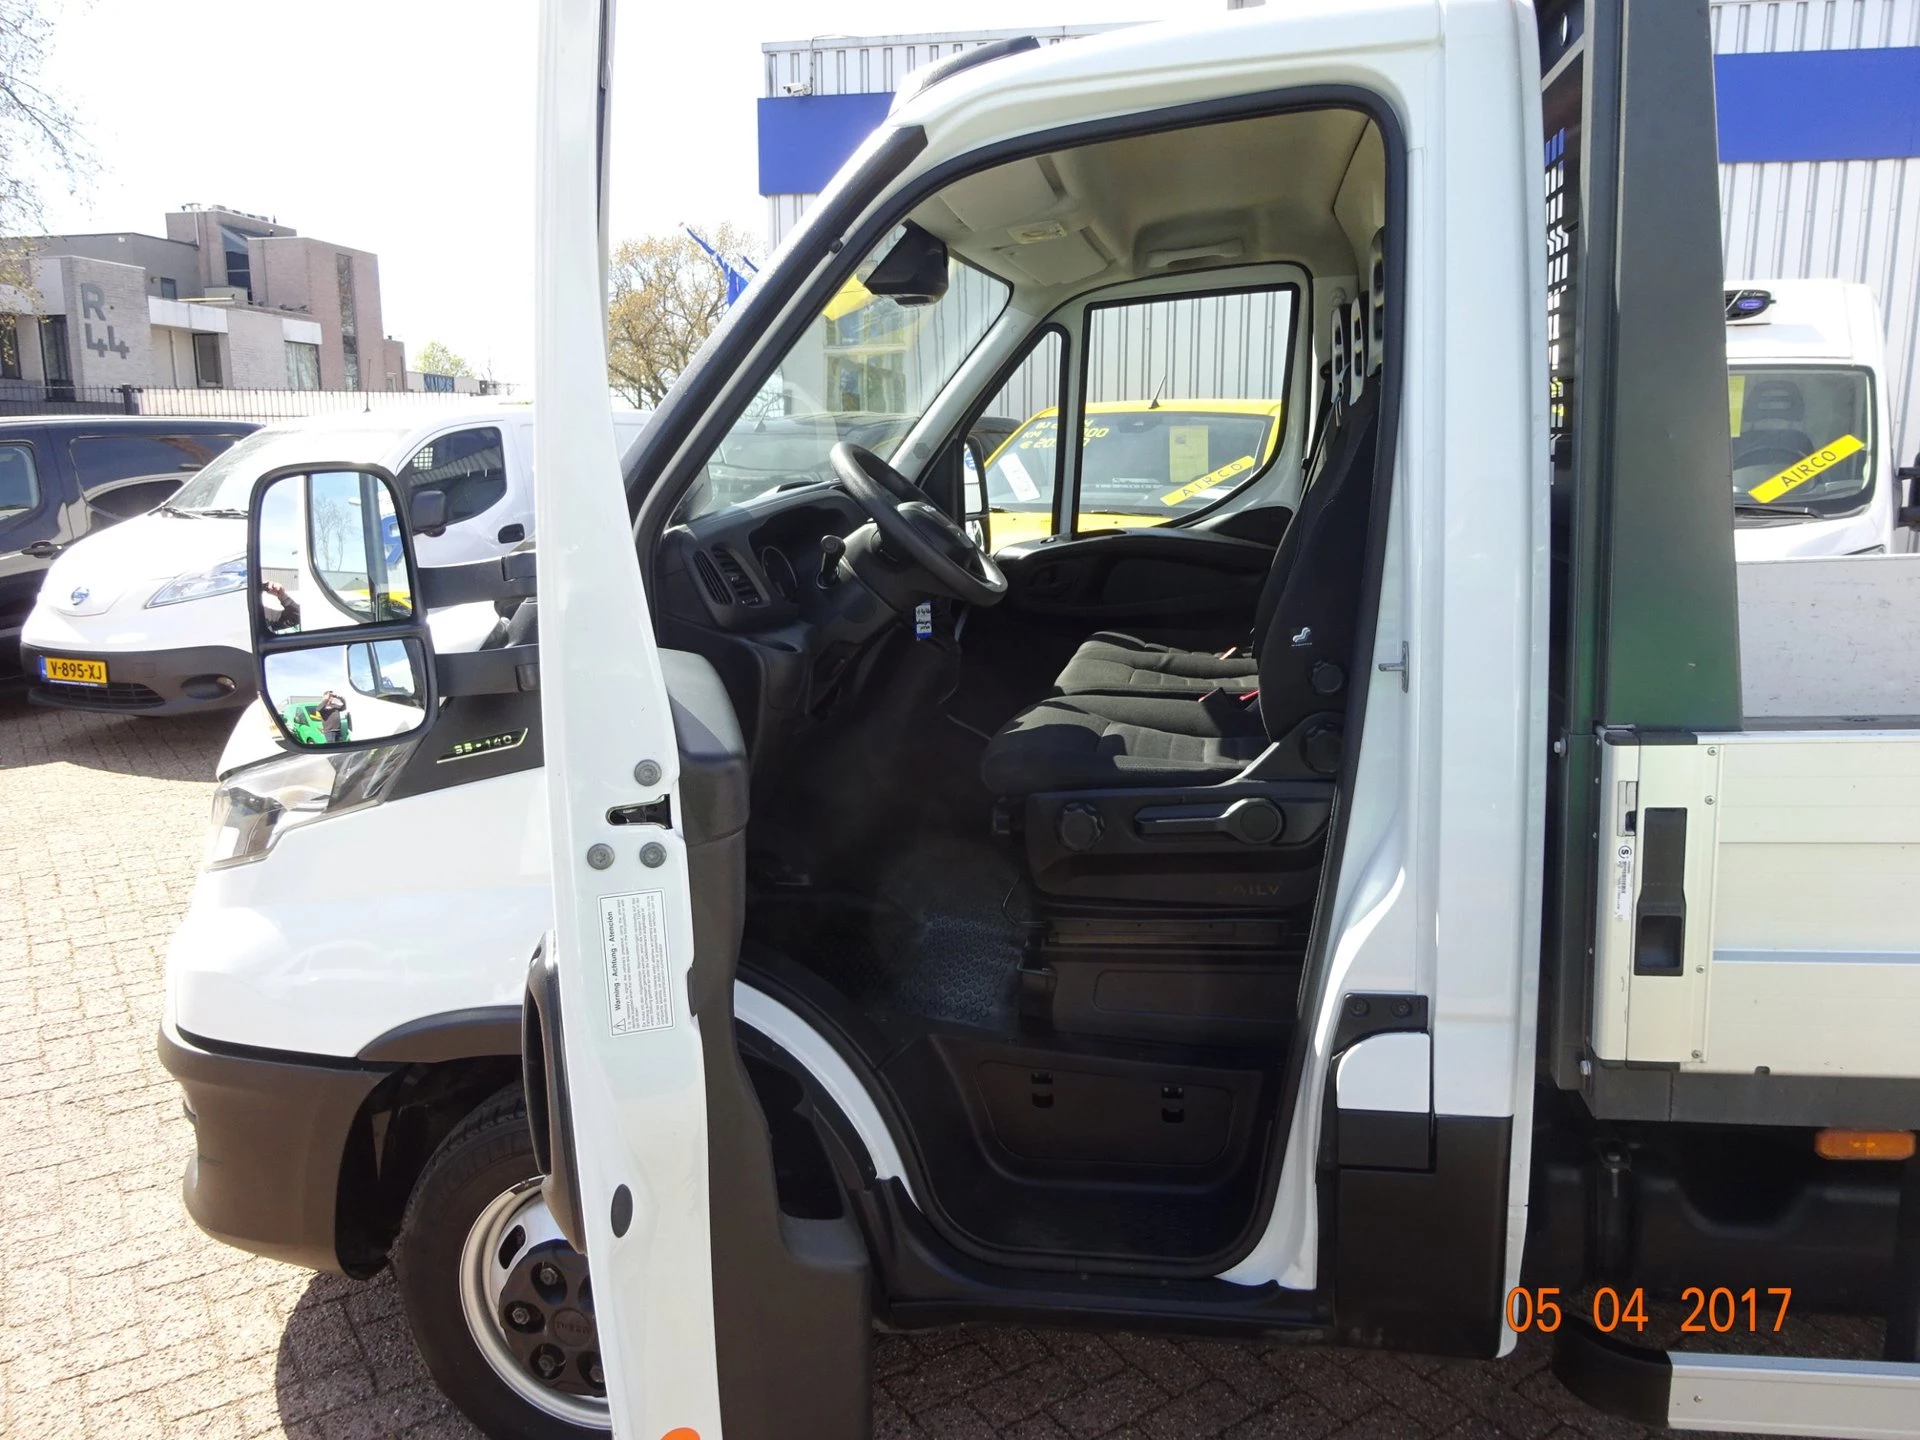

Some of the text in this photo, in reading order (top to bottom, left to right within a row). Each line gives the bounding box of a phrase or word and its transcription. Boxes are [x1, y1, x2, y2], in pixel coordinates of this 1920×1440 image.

[84, 323, 130, 359] 44
[1182, 463, 1244, 498] AIRCO
[1781, 450, 1837, 487] AIRCO
[50, 661, 102, 680] V-895-XJ
[607, 911, 615, 942] Atención
